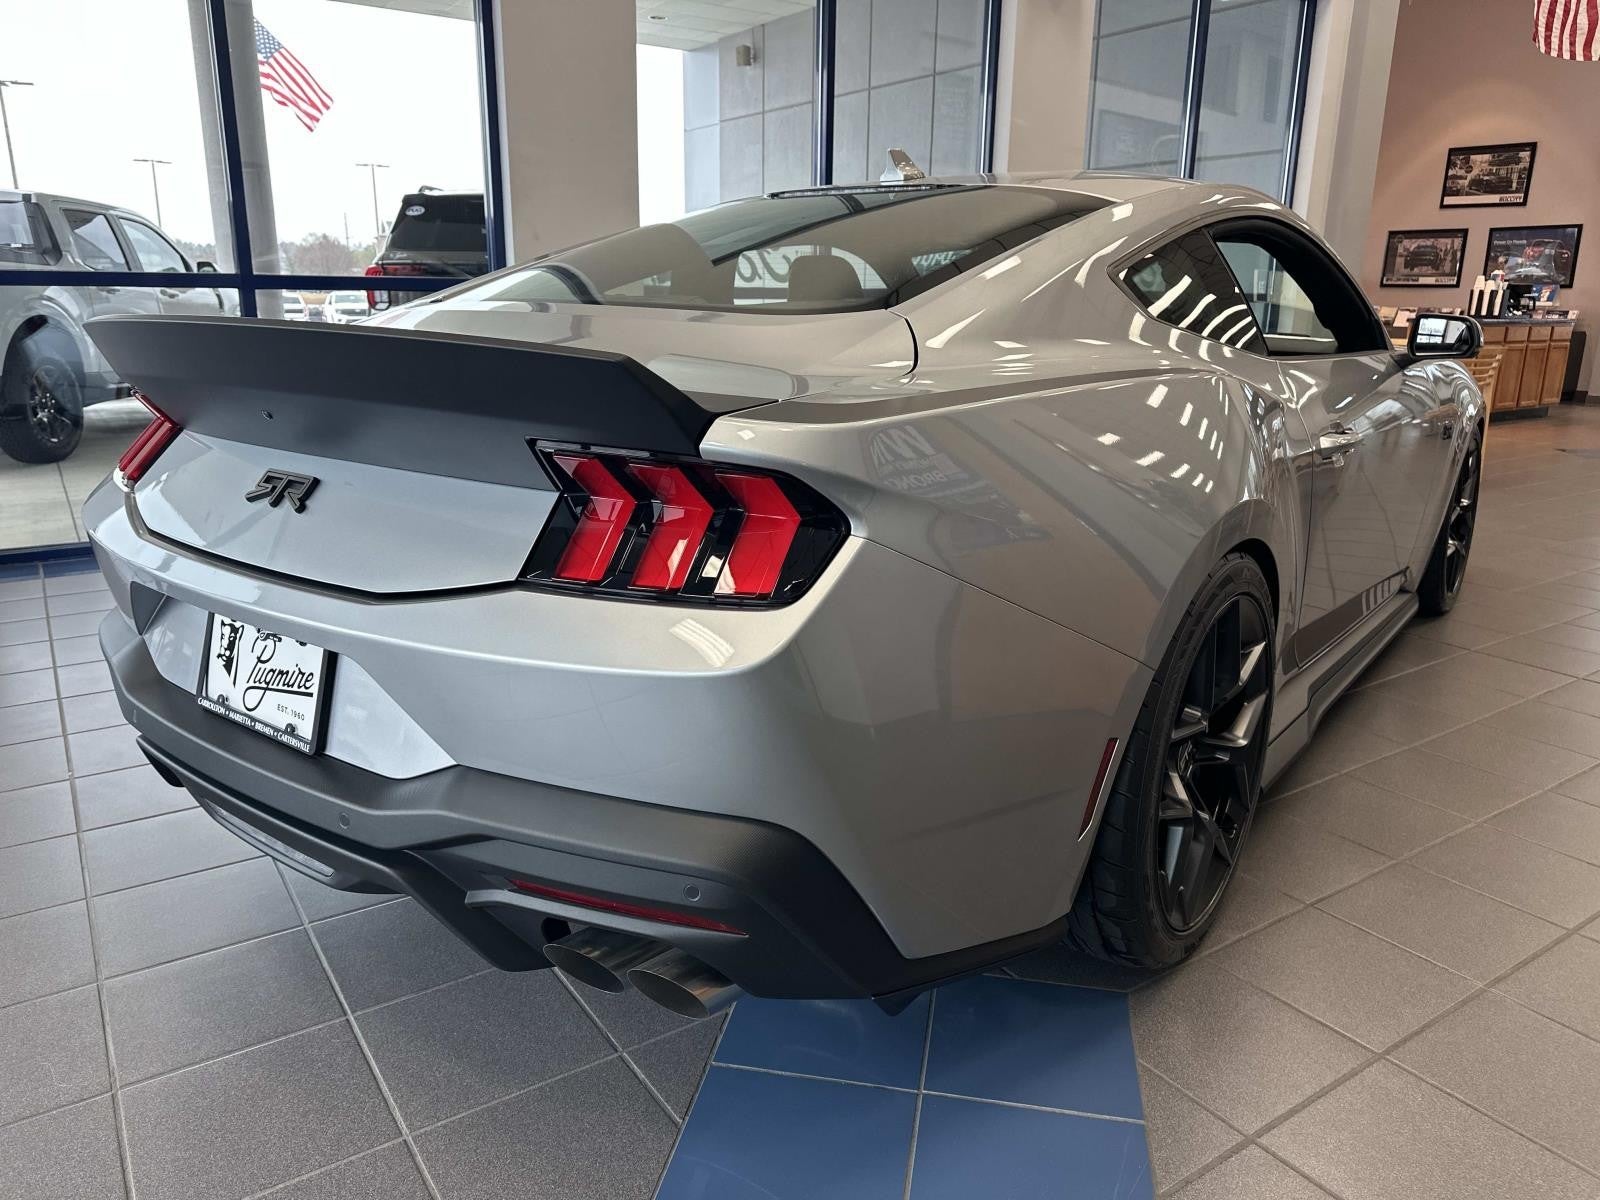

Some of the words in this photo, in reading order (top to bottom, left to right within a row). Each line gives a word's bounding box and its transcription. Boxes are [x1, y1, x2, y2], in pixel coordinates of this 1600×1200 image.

[243, 632, 314, 712] Pugmire
[228, 710, 251, 727] MARIETTA
[254, 721, 274, 736] BREMEN
[277, 731, 310, 753] CARTERSVILLE
